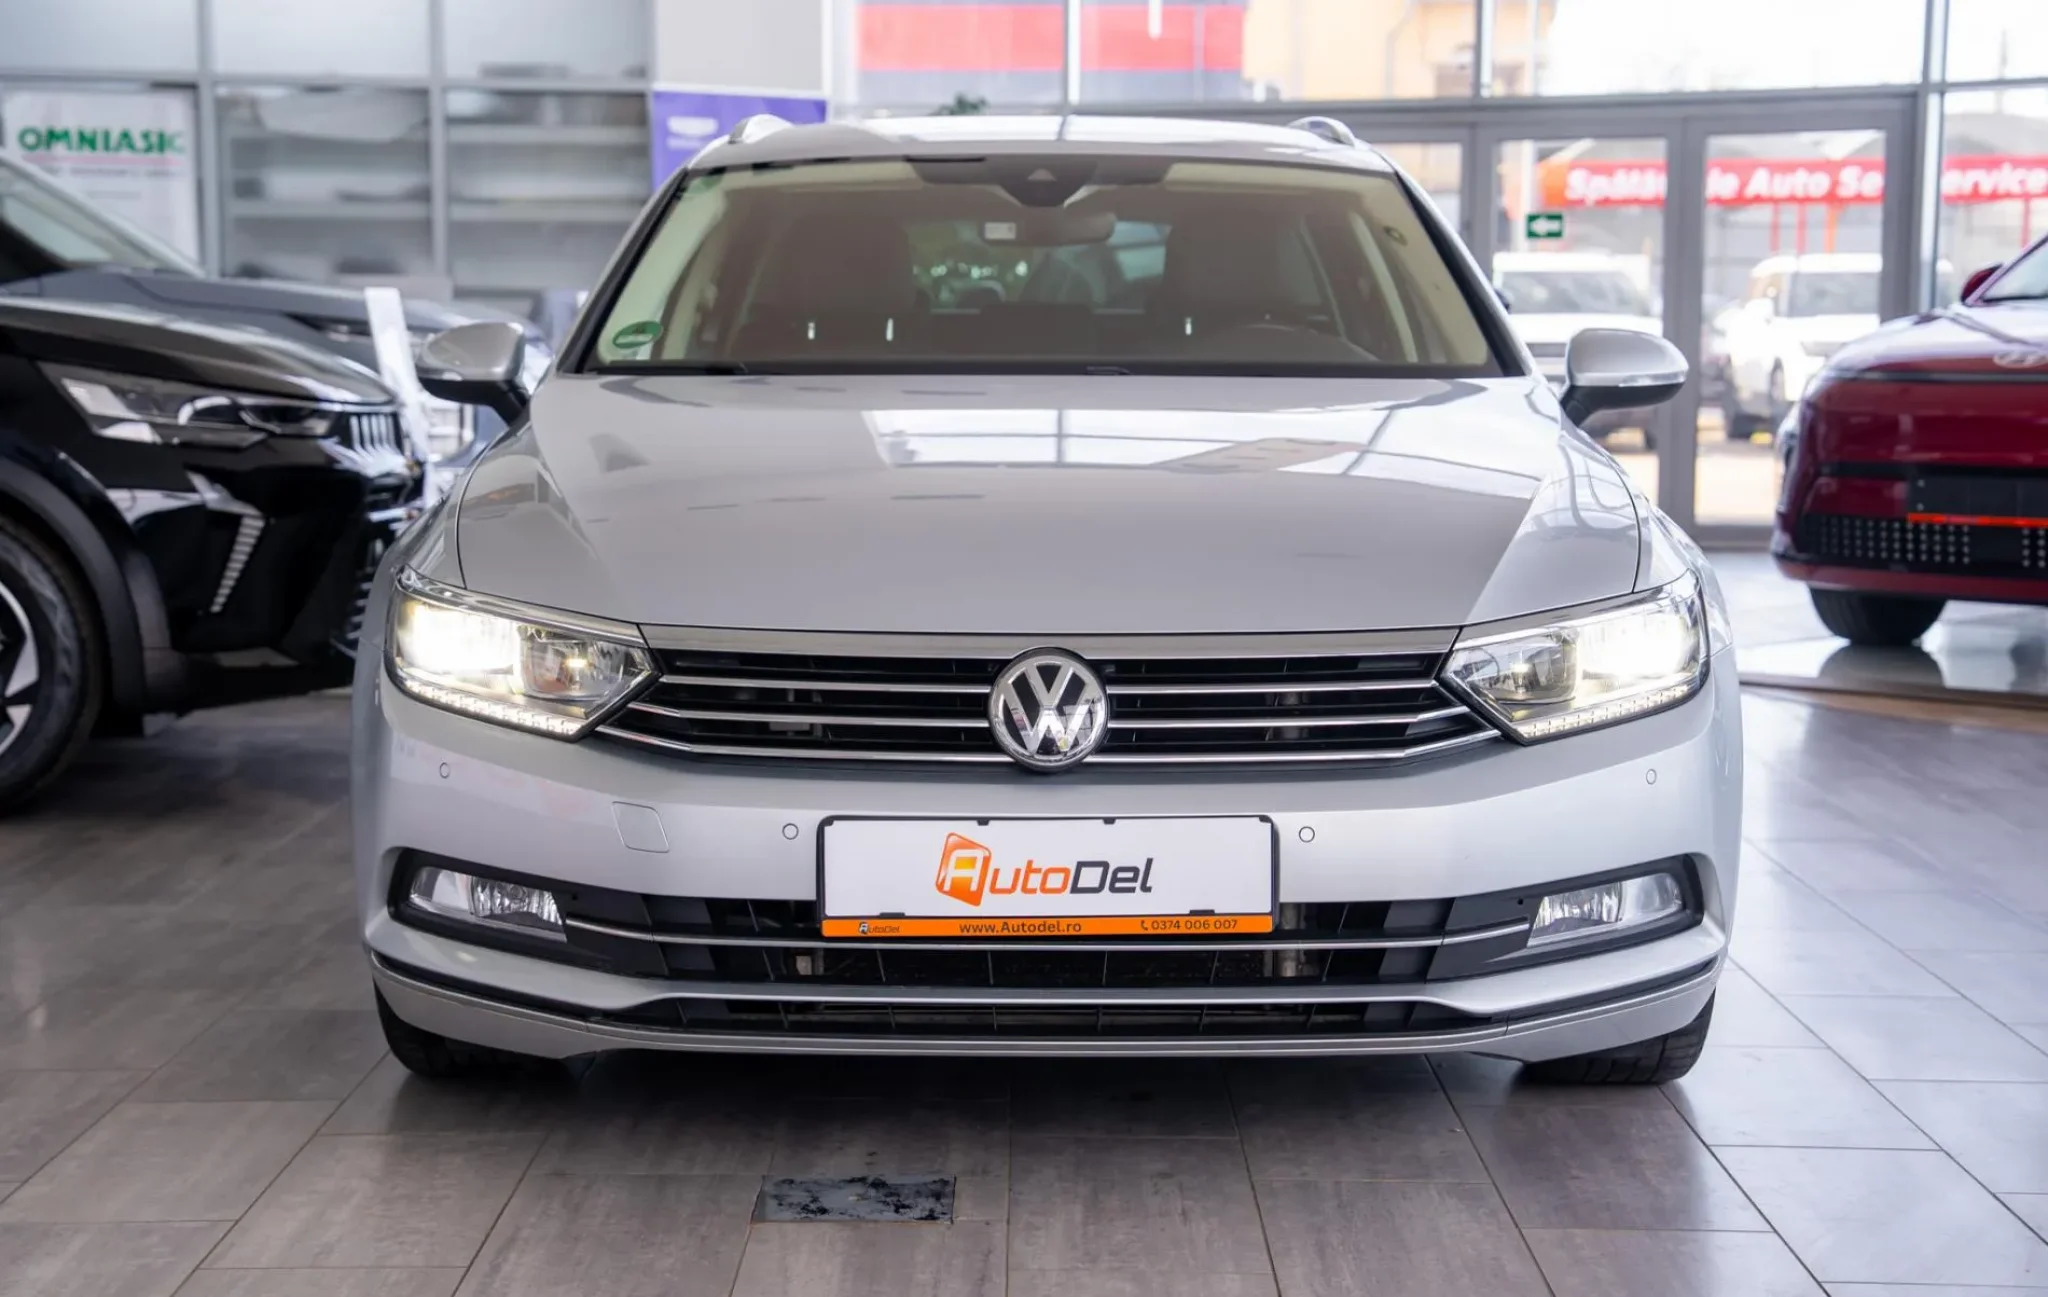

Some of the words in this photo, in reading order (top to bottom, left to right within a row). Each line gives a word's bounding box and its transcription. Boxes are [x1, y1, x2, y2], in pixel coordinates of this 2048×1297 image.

[1743, 166, 1831, 200] Auto
[1836, 164, 1884, 200] Se
[1940, 162, 2048, 197] ervice
[941, 847, 1154, 896] AutoDel
[958, 920, 1082, 934] www.Autodel.ro
[1151, 919, 1181, 931] 0374
[1184, 919, 1210, 930] 006
[1213, 918, 1238, 930] 007
